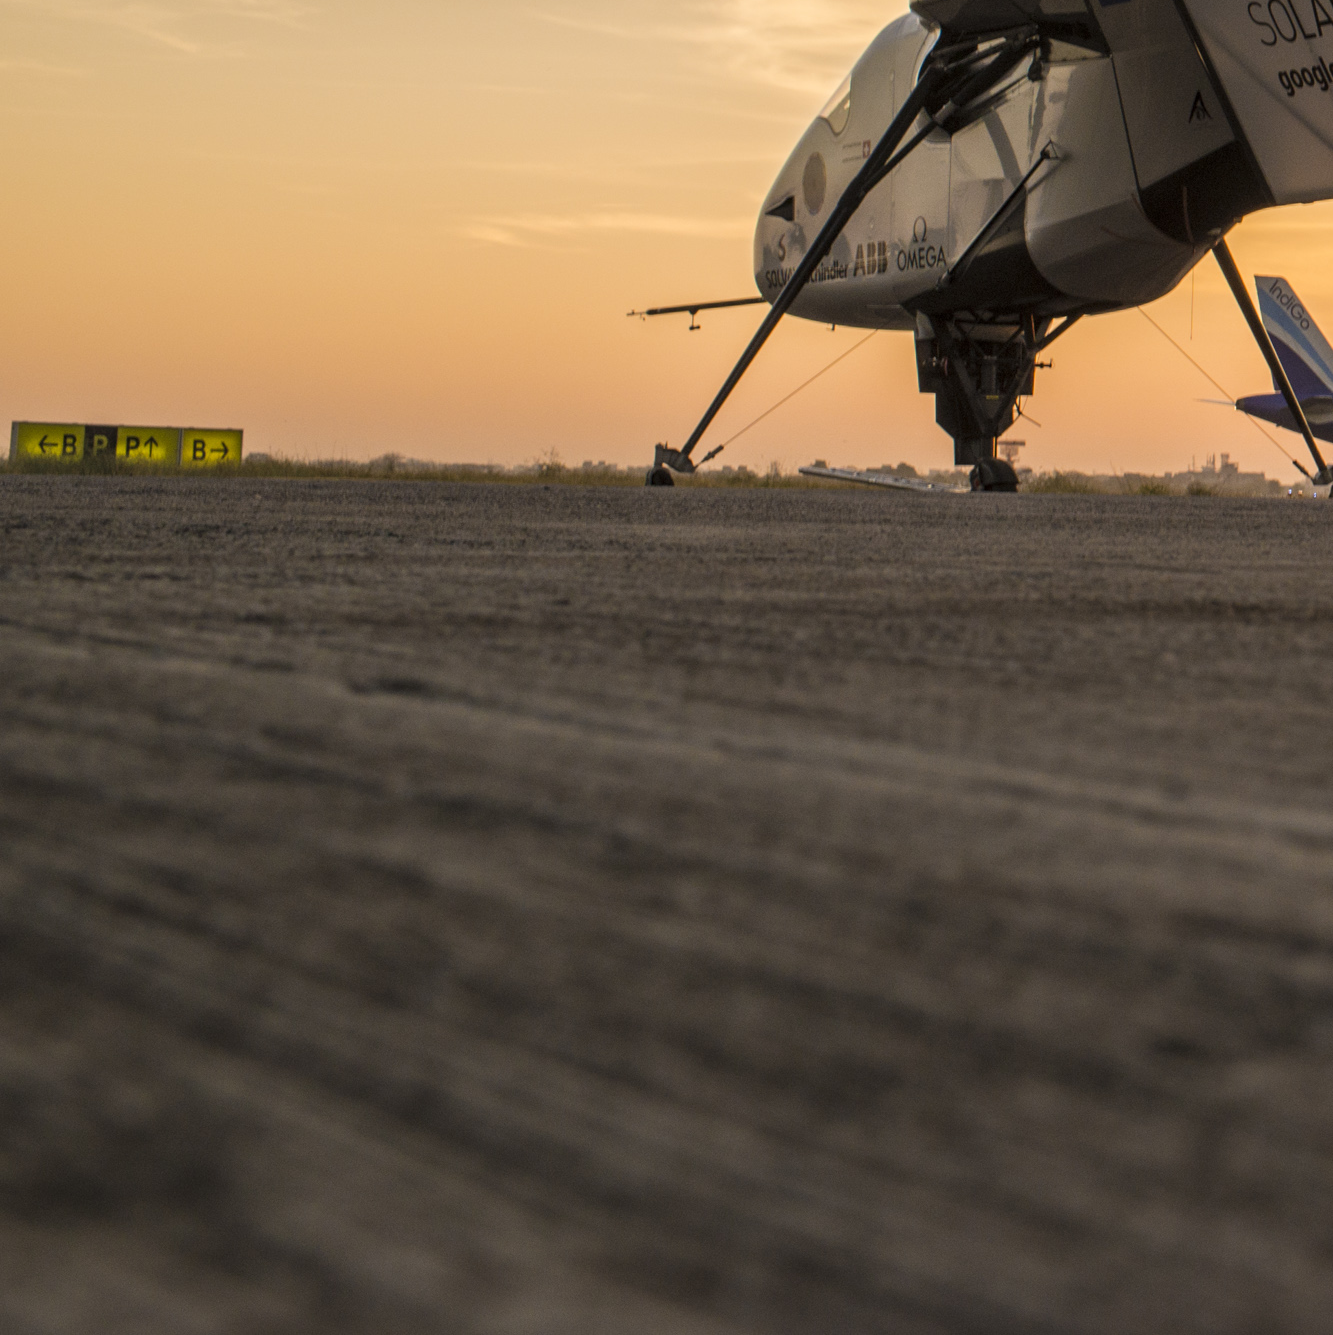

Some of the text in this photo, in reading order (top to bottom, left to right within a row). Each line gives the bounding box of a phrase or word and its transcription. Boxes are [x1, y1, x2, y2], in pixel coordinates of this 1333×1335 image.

[853, 241, 888, 277] ABB
[897, 245, 947, 272] OMEGA
[1269, 279, 1310, 331] IndiGo
[62, 434, 206, 461] B P P B
